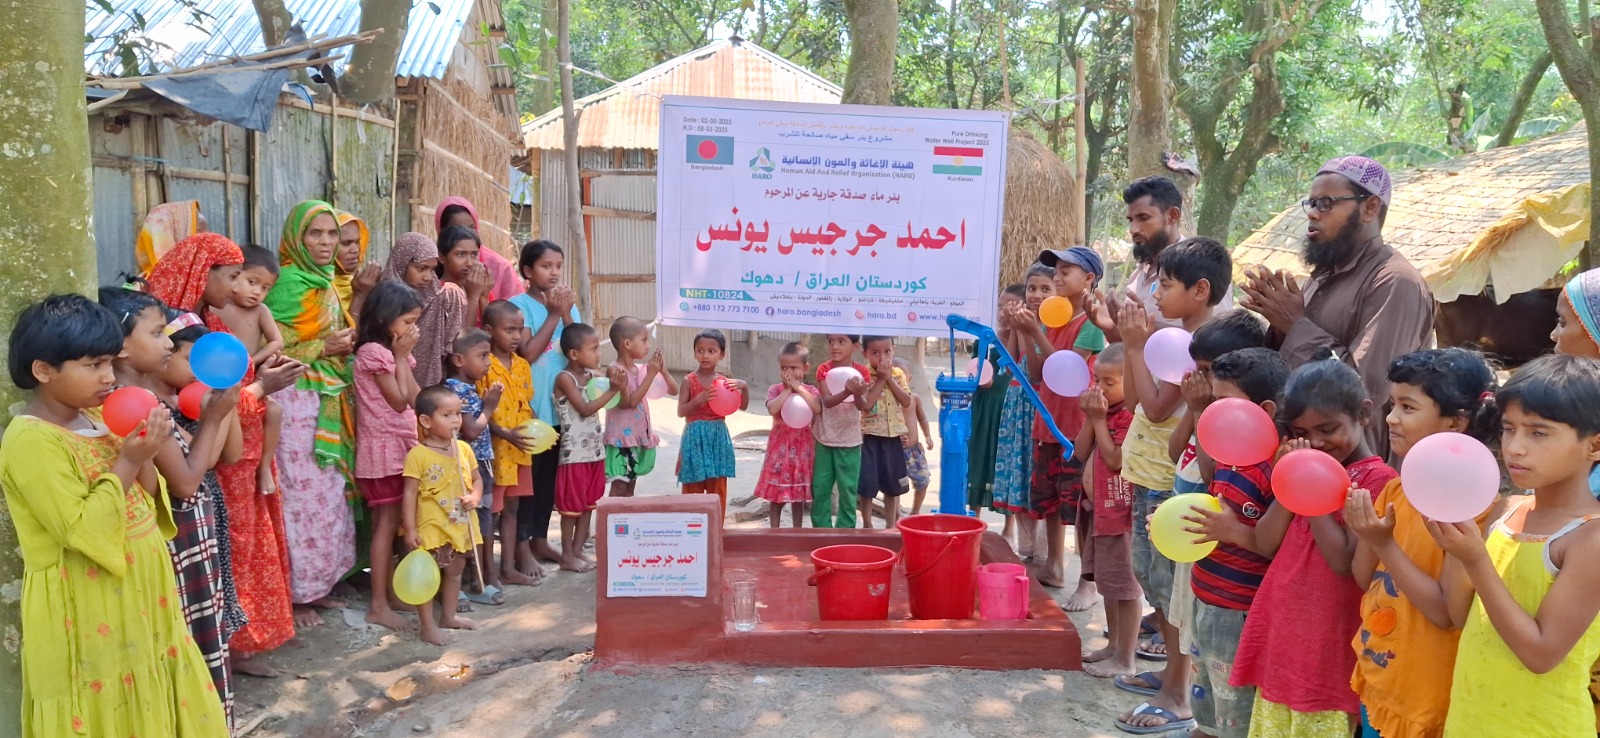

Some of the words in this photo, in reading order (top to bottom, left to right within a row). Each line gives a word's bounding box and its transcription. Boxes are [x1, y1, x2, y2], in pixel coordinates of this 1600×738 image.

[965, 131, 988, 139] Drinking
[851, 170, 891, 178] Organization
[892, 172, 915, 180] (HARO)
[764, 187, 794, 199] المرحوم
[795, 188, 810, 200] عن
[812, 188, 837, 201] جارية
[840, 189, 866, 200] صدقة
[871, 190, 884, 201] ماء
[695, 205, 770, 255] يونس
[896, 217, 966, 250] احمد
[777, 219, 888, 258] جرجيس
[740, 269, 784, 288] دهوك
[805, 273, 850, 290] العراق
[855, 275, 928, 294] كوردستان
[686, 289, 744, 300] NHT-10824
[727, 305, 741, 313] 773
[742, 306, 760, 314] 7100
[777, 307, 842, 318] haro.bangladesh
[867, 311, 897, 320] haro.bd
